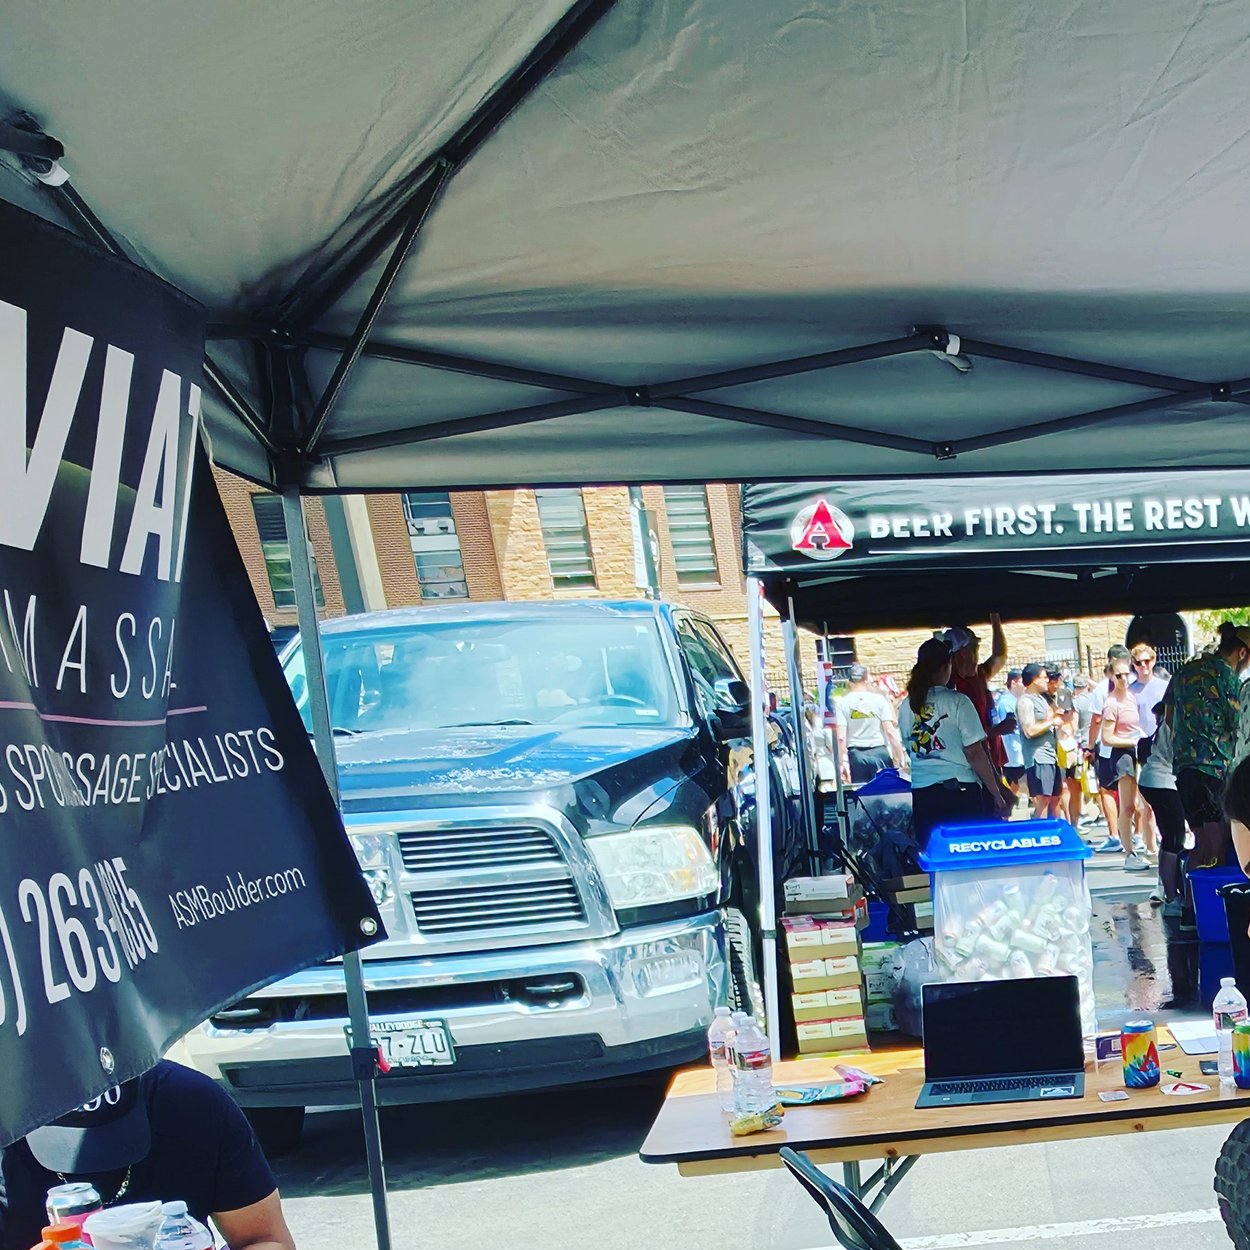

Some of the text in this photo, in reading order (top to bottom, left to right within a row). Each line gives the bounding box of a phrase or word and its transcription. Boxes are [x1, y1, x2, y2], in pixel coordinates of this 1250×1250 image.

[870, 513, 953, 539] BEER
[964, 503, 1064, 537] FIRST.
[1072, 501, 1134, 534] THE
[1145, 496, 1222, 531] REST
[949, 836, 1062, 853] RECYCLABLES
[168, 867, 306, 929] ASMBoulder.com
